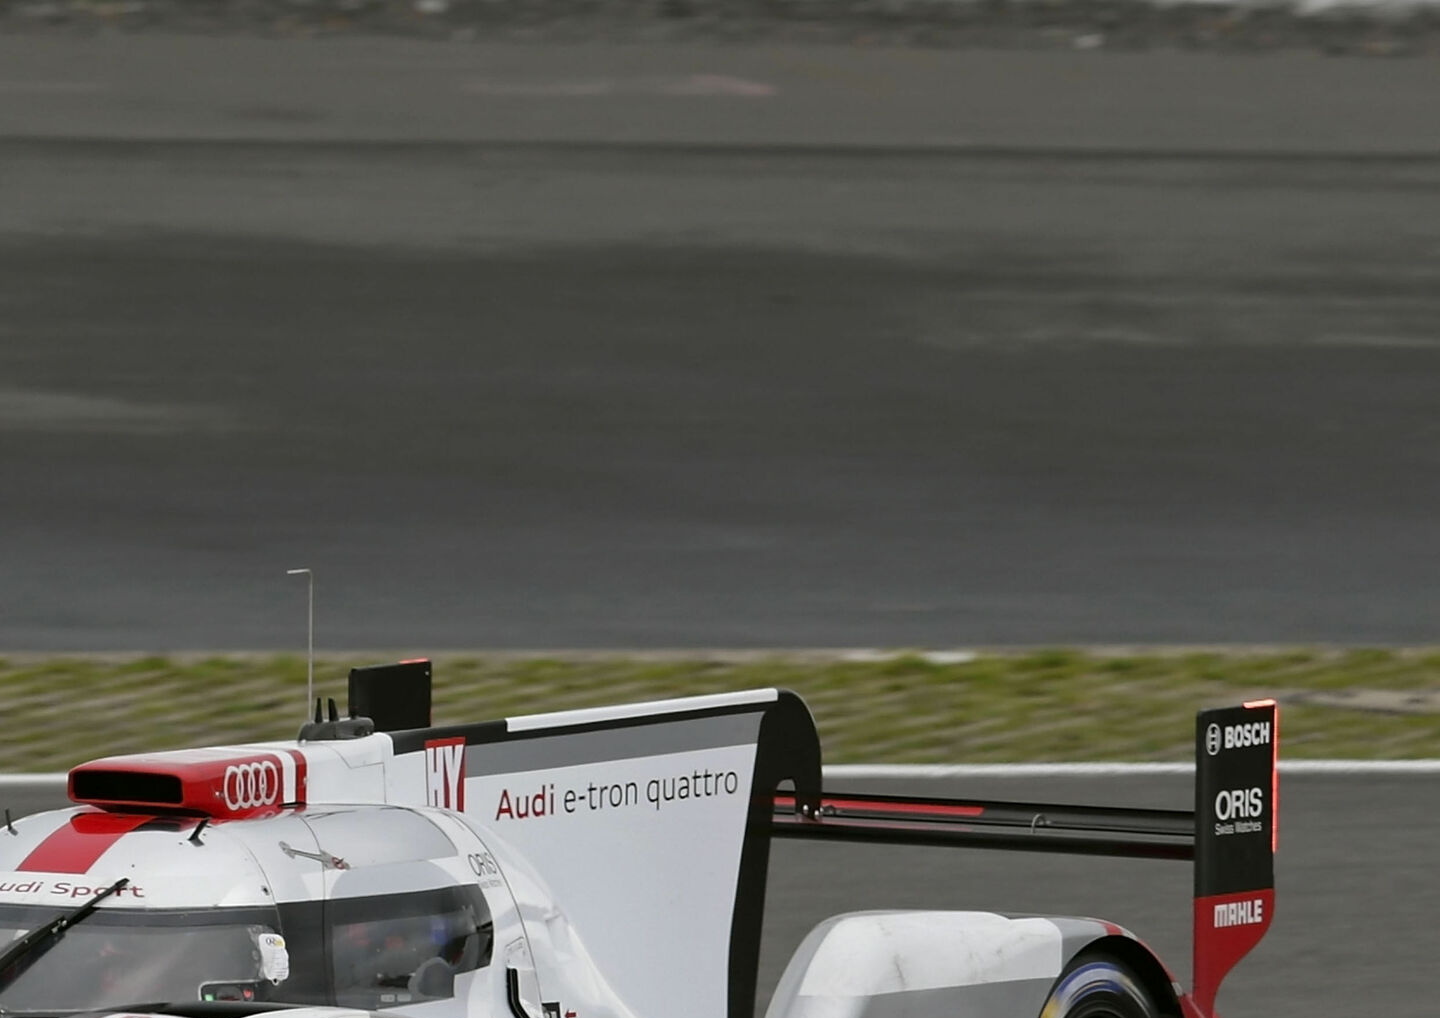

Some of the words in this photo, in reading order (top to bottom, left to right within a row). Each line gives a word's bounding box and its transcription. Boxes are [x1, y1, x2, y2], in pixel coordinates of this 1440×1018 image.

[1224, 721, 1270, 750] BOSCH
[426, 743, 465, 812] HY
[495, 784, 555, 821] Audi
[563, 780, 638, 813] e-tron
[646, 768, 738, 811] quattro
[1215, 787, 1263, 821] ORIS
[50, 881, 145, 898] Sport
[1213, 899, 1263, 928] MAHLE
